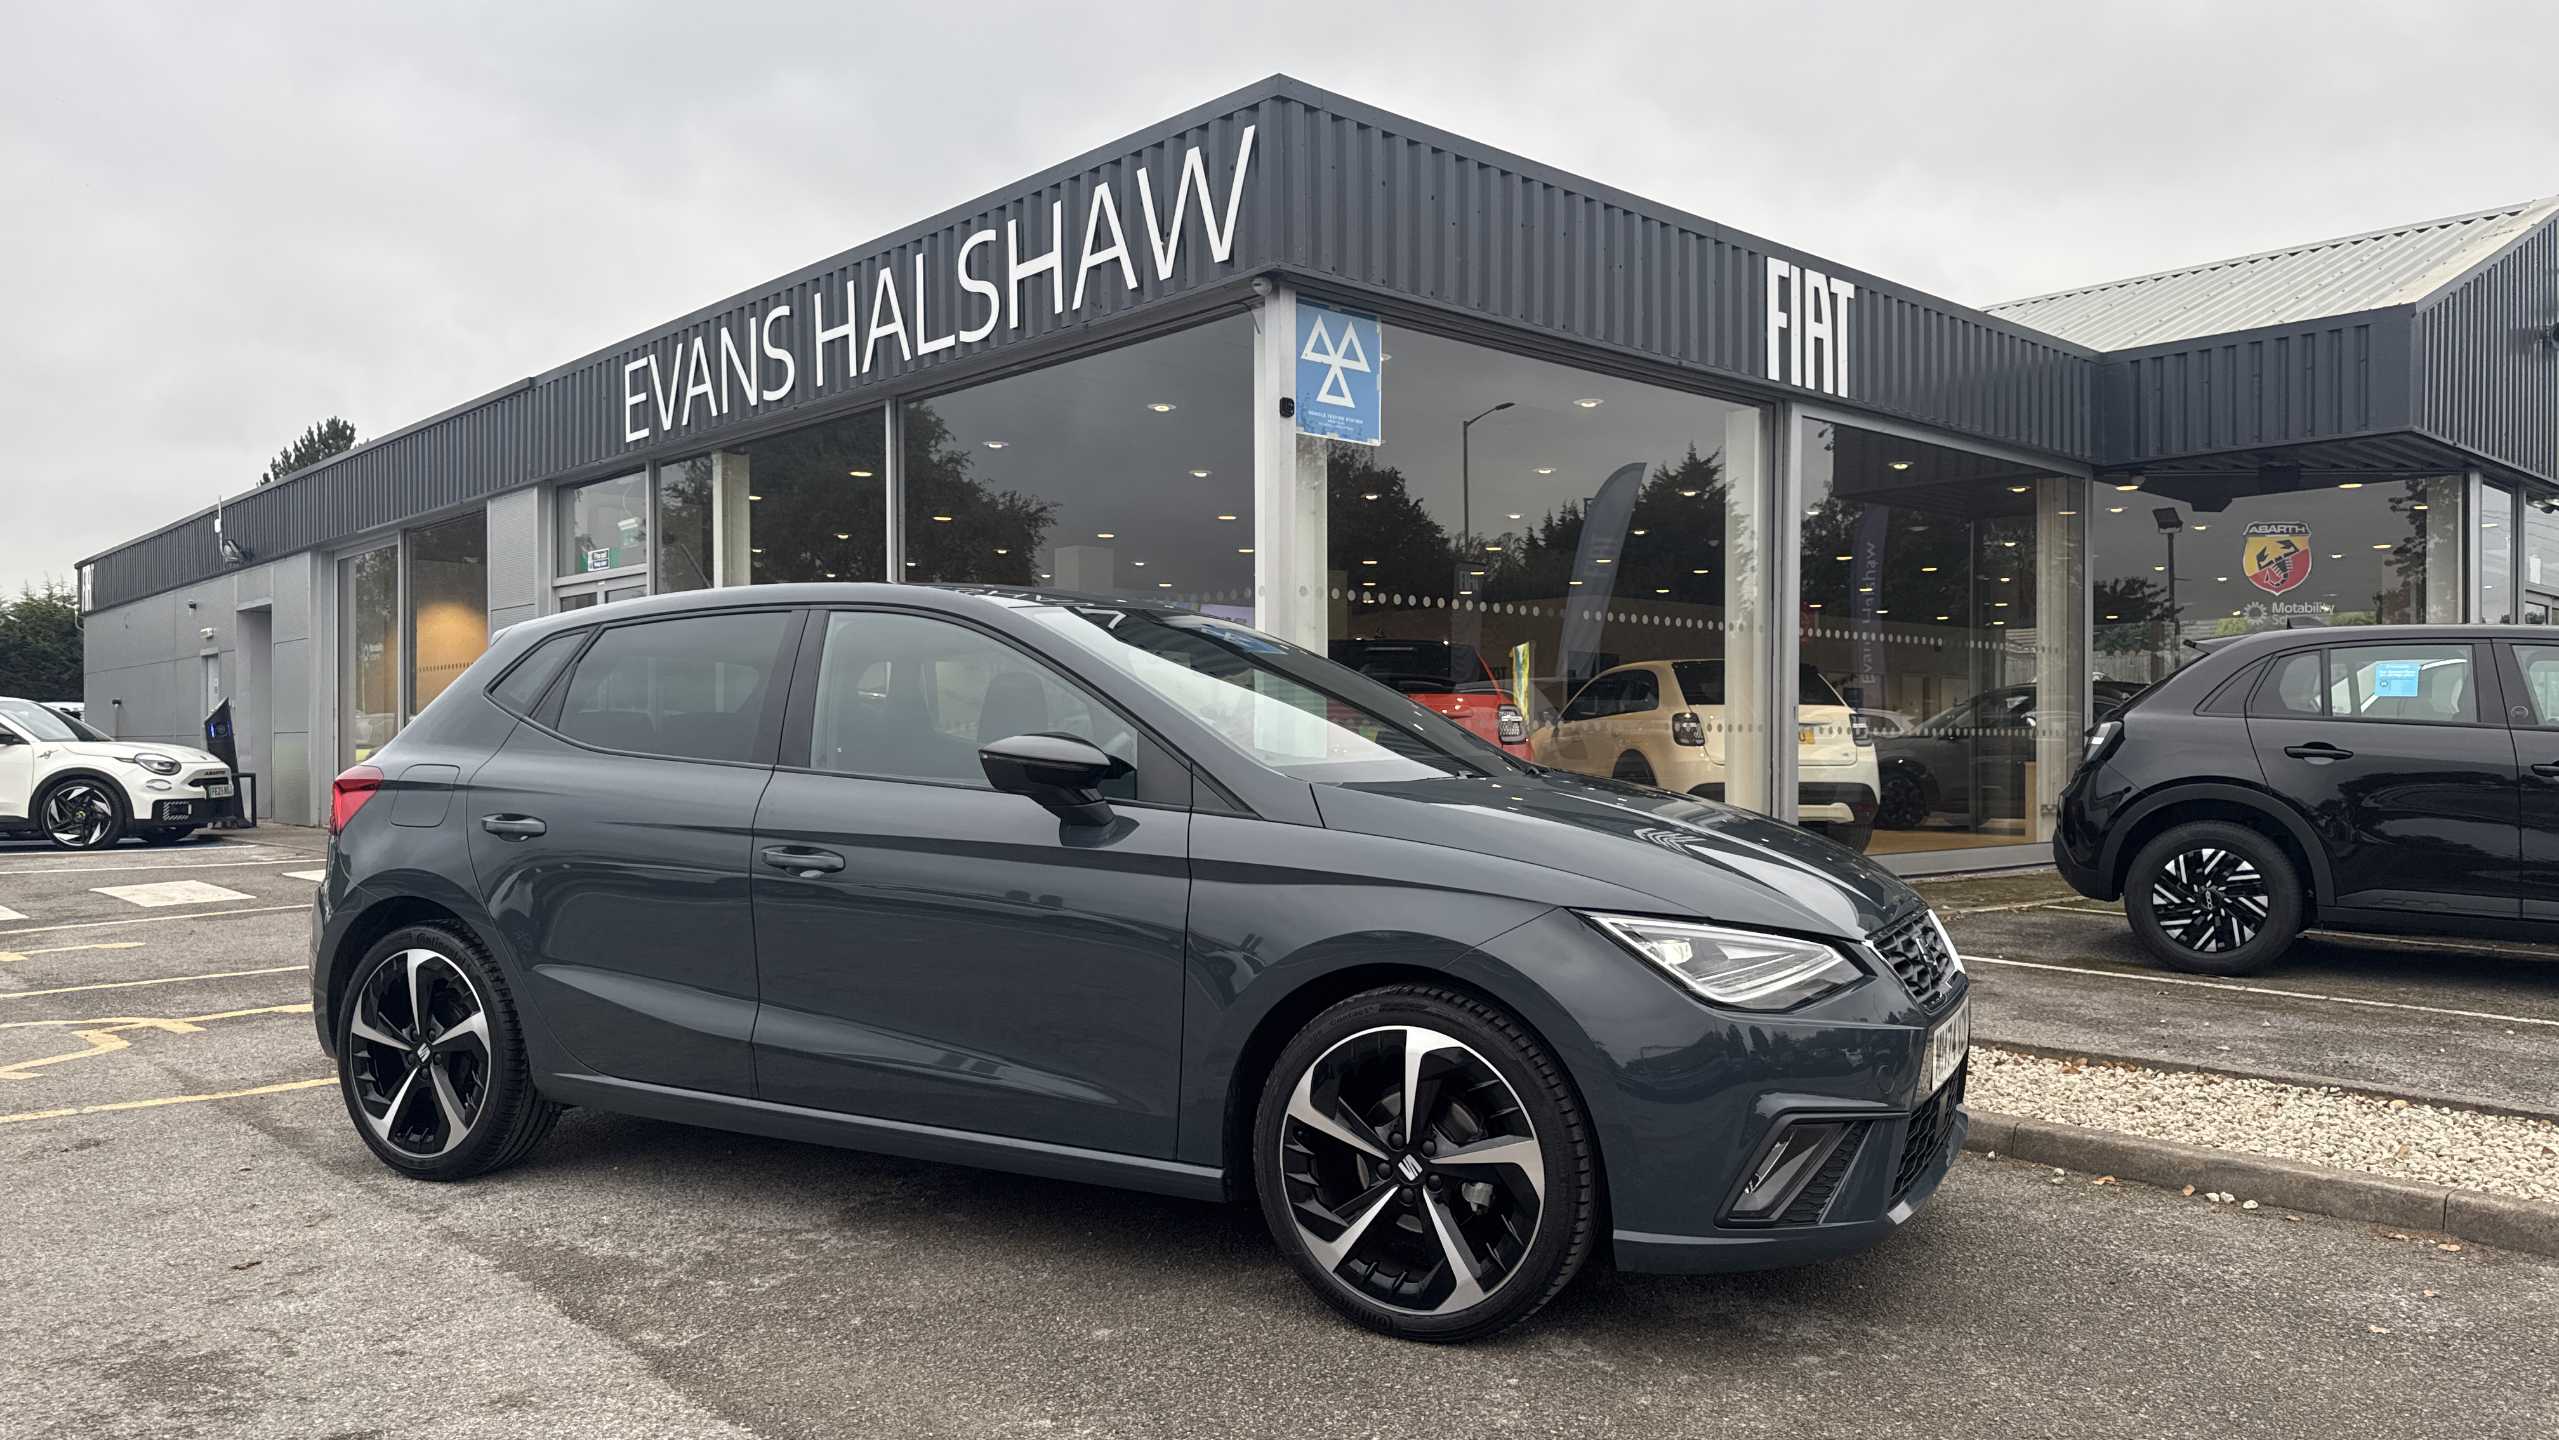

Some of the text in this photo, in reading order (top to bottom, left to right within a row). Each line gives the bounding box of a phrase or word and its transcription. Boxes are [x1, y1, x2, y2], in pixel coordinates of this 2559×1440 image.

[624, 124, 1255, 443] EVANS HALSHAW
[1767, 256, 1855, 398] FIAT
[2249, 524, 2306, 534] ABARTH
